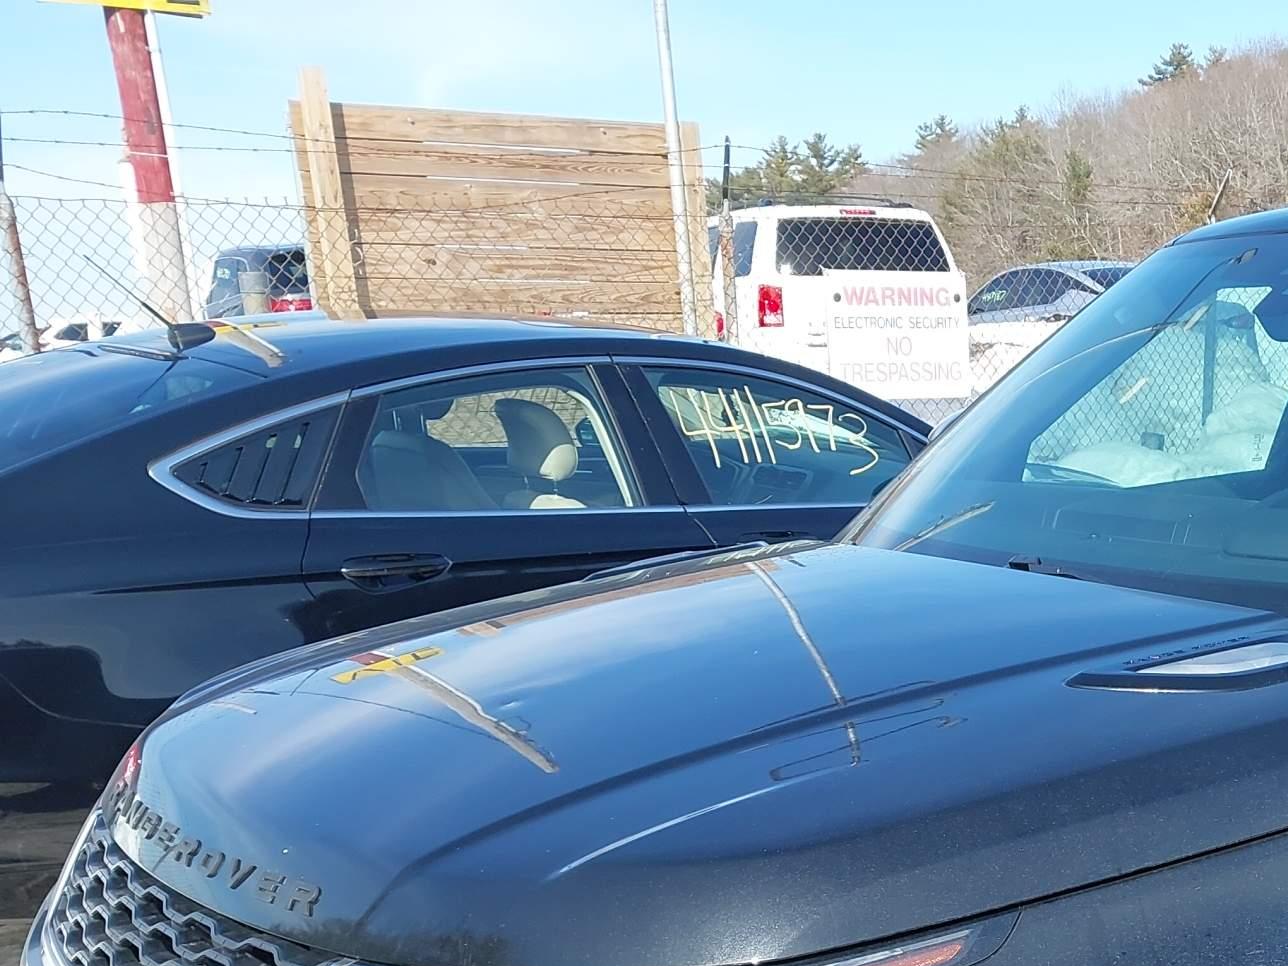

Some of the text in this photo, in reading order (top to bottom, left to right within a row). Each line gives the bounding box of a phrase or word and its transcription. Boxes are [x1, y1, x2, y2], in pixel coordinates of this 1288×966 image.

[843, 286, 951, 307] WARNING
[834, 316, 960, 329] ELECTRONIC SECURITY
[886, 336, 913, 356] NO
[840, 361, 962, 382] TRESPASSING
[669, 385, 879, 475] 44115973
